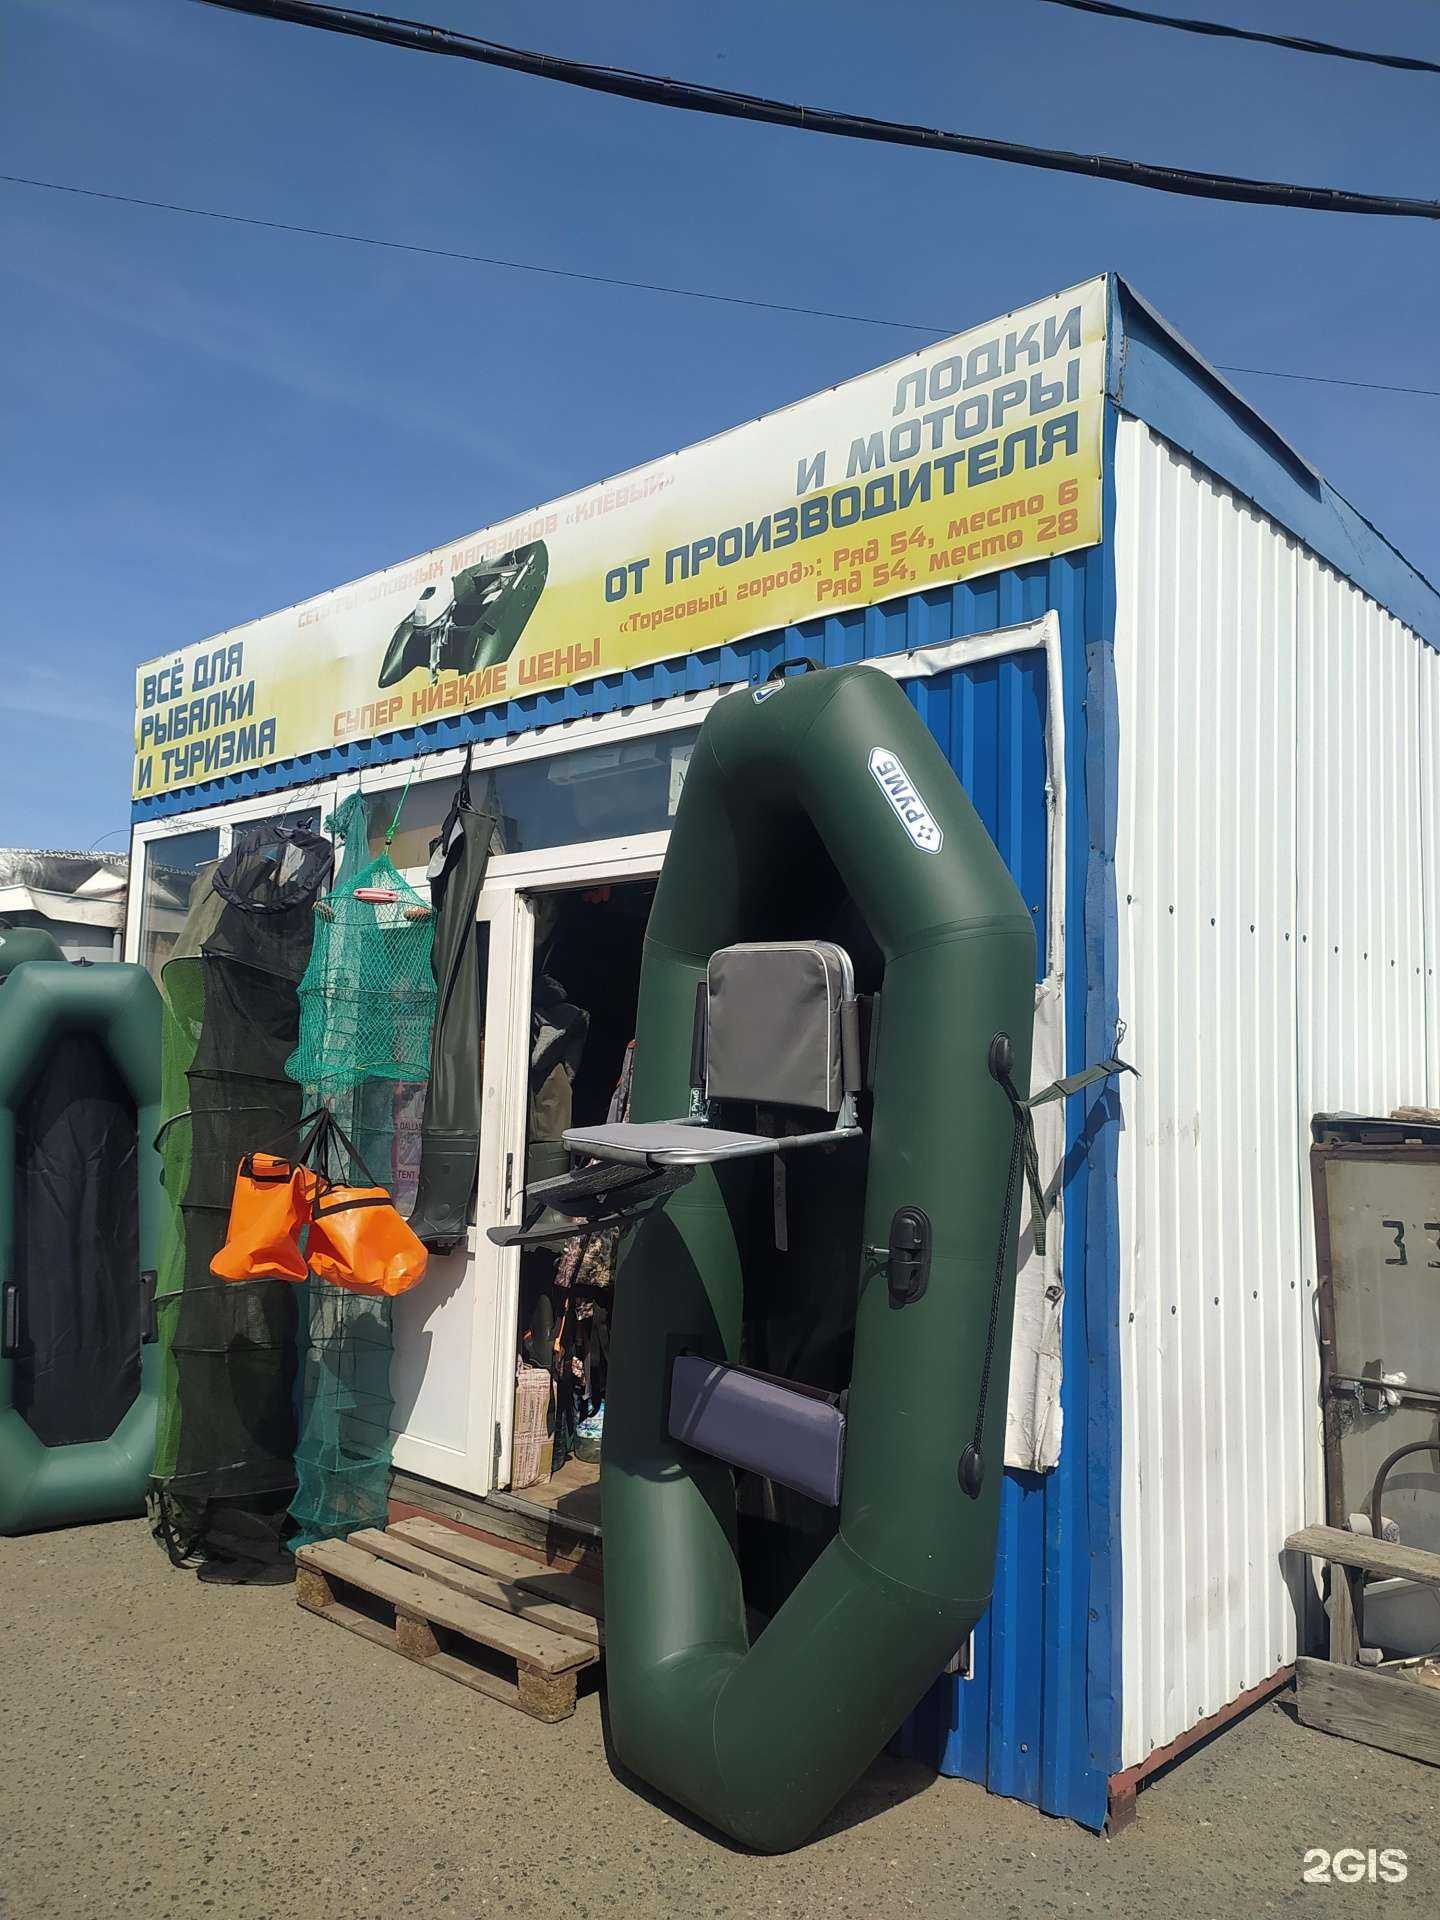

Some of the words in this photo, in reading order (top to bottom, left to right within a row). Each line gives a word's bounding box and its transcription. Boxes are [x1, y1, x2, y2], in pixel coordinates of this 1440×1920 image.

[892, 306, 1082, 416] ЛОДКИ
[796, 450, 826, 495] И
[846, 358, 1081, 478] МОТОРЫ
[604, 558, 650, 603] ОТ
[664, 410, 1079, 585] ПРОИЗВОДИТЕЛЯ
[815, 570, 863, 602] Ряд
[873, 558, 917, 588] 54,
[929, 528, 1024, 572] место
[1036, 508, 1079, 540] 28
[618, 586, 728, 635] «Торговый
[833, 537, 879, 573] Ряд
[890, 526, 936, 554] 54,
[948, 493, 1044, 540] место
[1058, 479, 1080, 505] 6
[140, 680, 255, 750] РЫБАЛКИ
[143, 657, 183, 709] ВСЁ
[192, 641, 245, 693] ДЛЯ
[332, 695, 404, 738] СУПЕР
[411, 664, 508, 718] НИЗКИЕ
[518, 637, 602, 686] ЦЕНЫ
[138, 754, 153, 792] И
[161, 717, 277, 782] ТУРИЗМА
[876, 760, 925, 823] РУМБ
